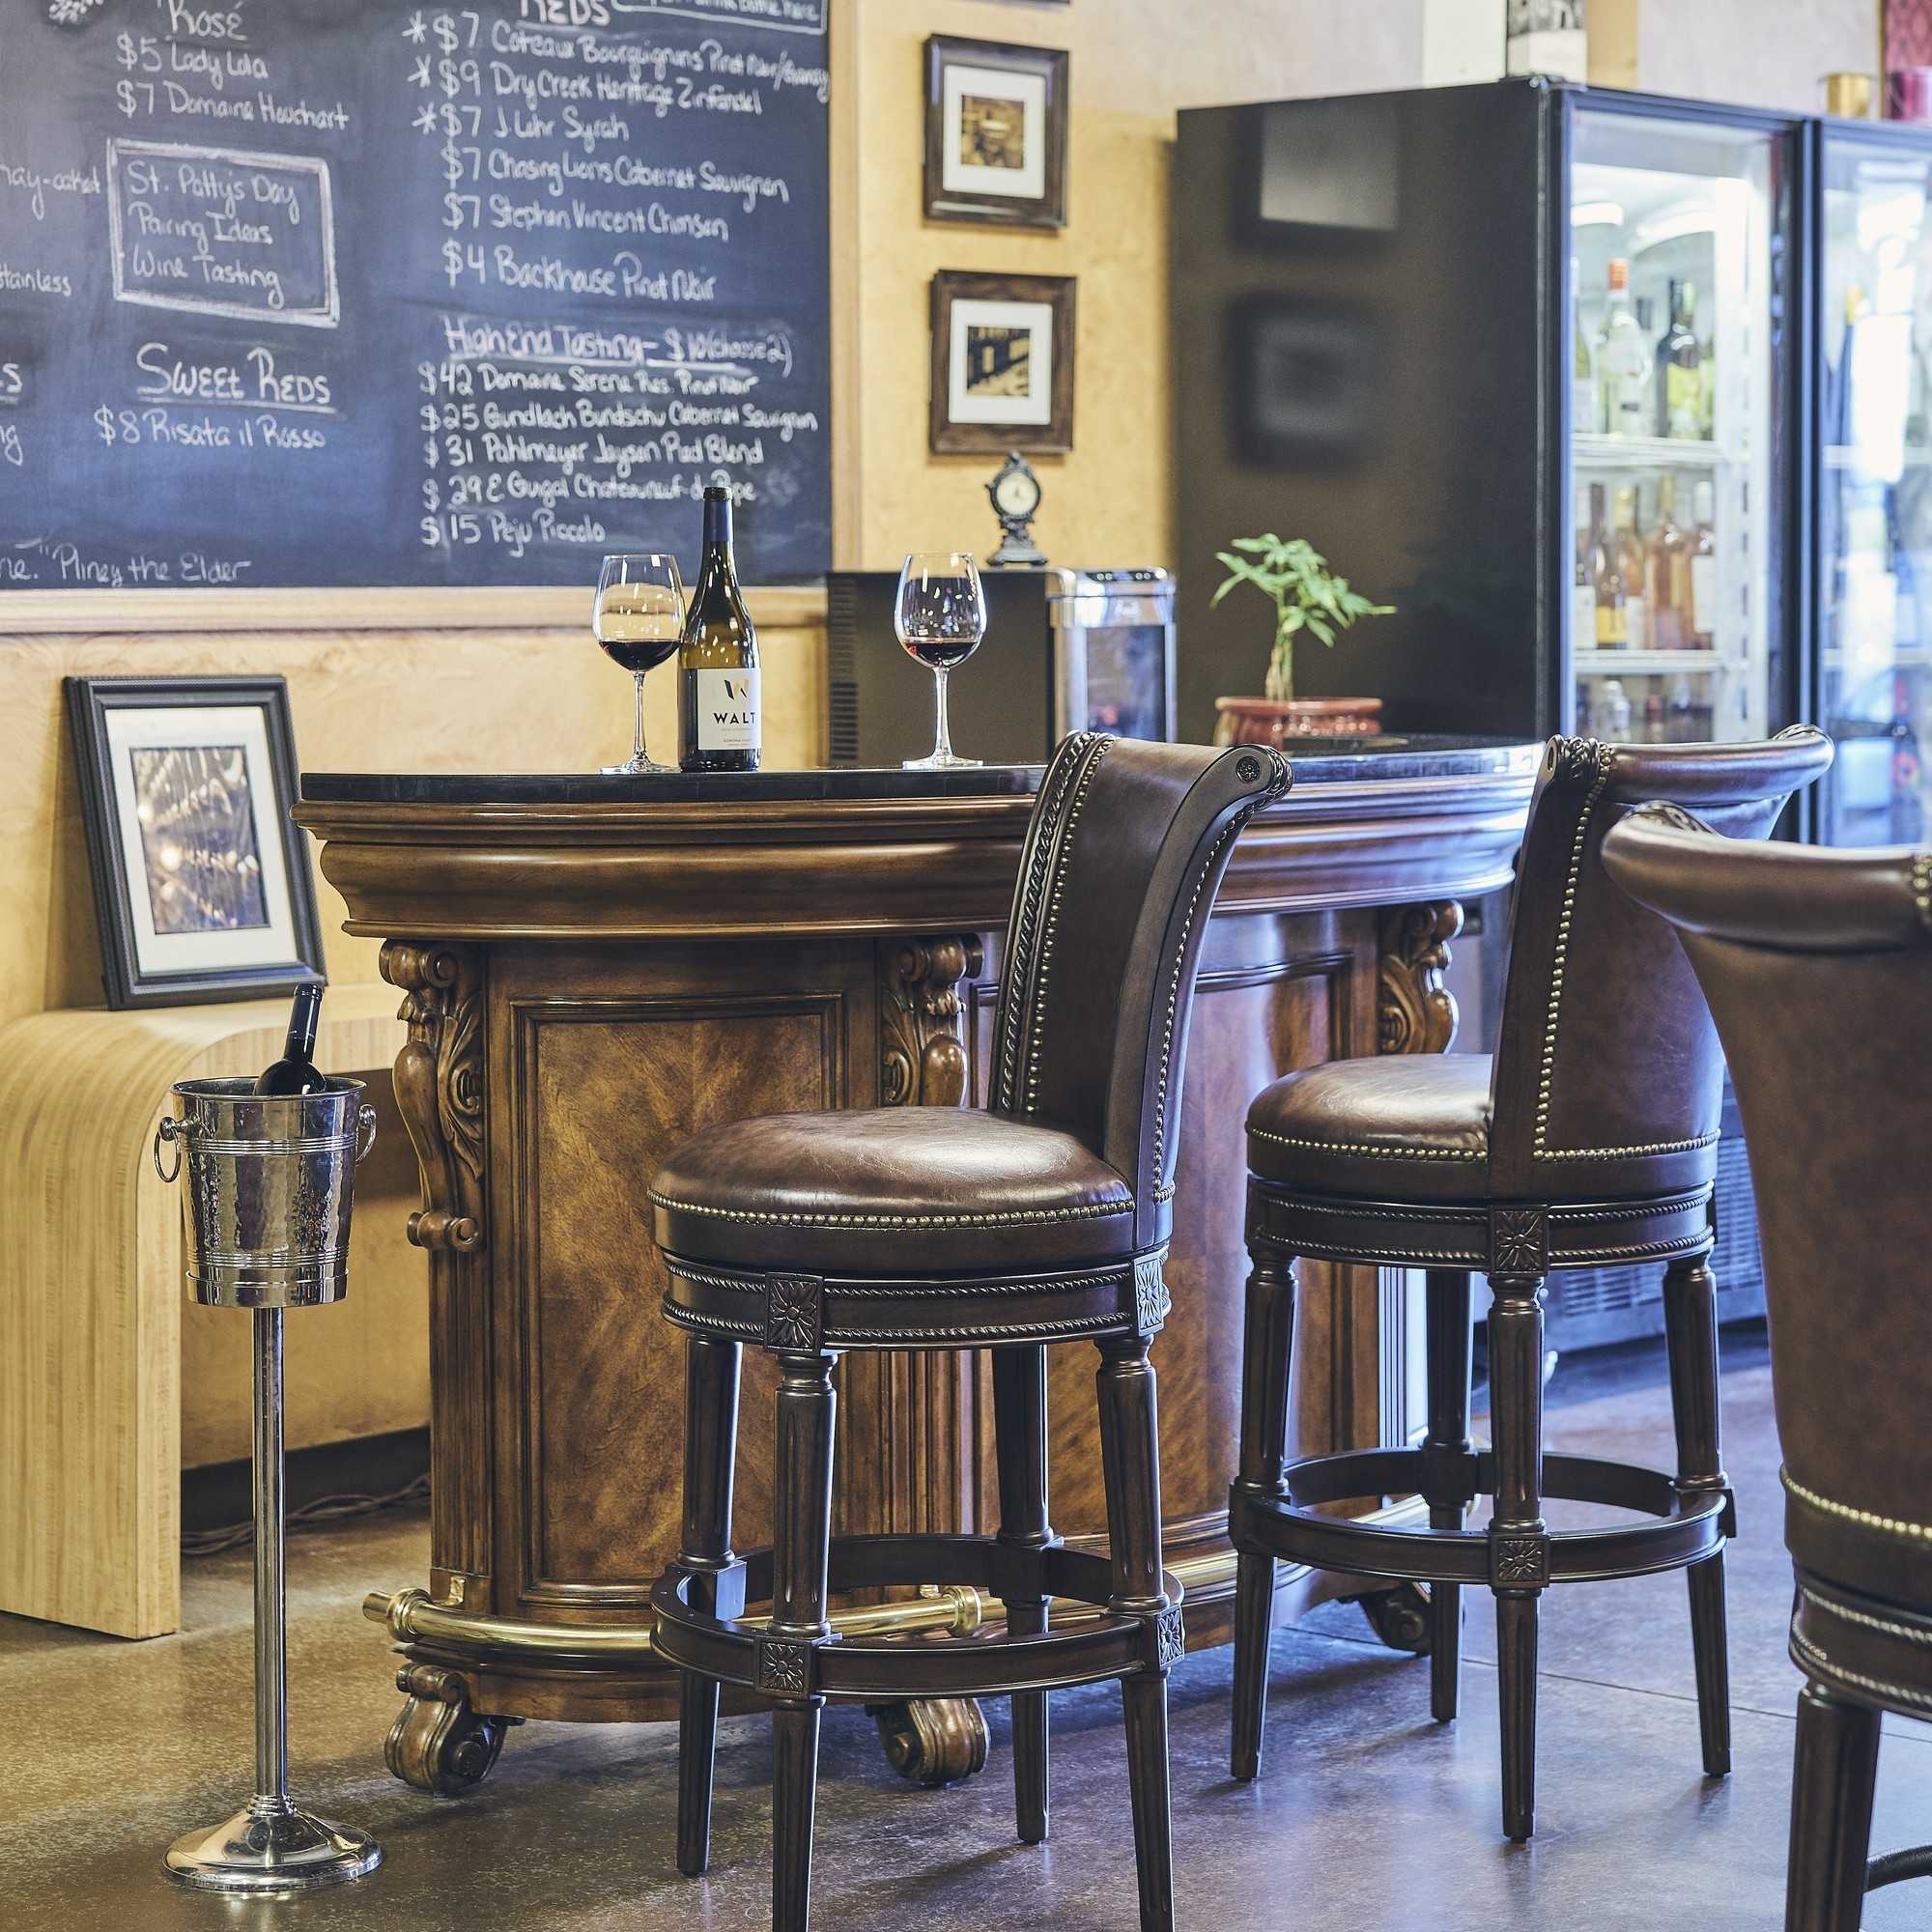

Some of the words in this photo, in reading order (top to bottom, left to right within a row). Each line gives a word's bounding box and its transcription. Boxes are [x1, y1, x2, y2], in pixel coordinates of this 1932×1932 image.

[433, 12, 480, 55] $7
[116, 31, 162, 71] $5
[170, 43, 224, 91] Lady
[438, 58, 482, 98] $9
[490, 60, 537, 111] Dry
[116, 79, 155, 118] $7
[162, 80, 254, 121] Domaine
[440, 102, 482, 137] $7
[562, 104, 629, 155] Syrah
[127, 159, 169, 194] St.
[251, 173, 300, 225] Day
[440, 138, 482, 189] $7
[488, 148, 564, 197] Chasing
[127, 200, 210, 256] Pairing
[205, 210, 273, 245] Ideas
[440, 191, 481, 231] $7
[132, 243, 189, 278] Wine
[191, 253, 285, 310] Tasting
[440, 237, 486, 289] $4
[494, 243, 618, 297] Backhouse
[612, 251, 668, 302] Pinot
[94, 403, 140, 447] $8
[142, 407, 231, 448] Risata
[255, 413, 327, 450] Rosso
[711, 469, 757, 508] Ppe
[128, 555, 170, 582] the
